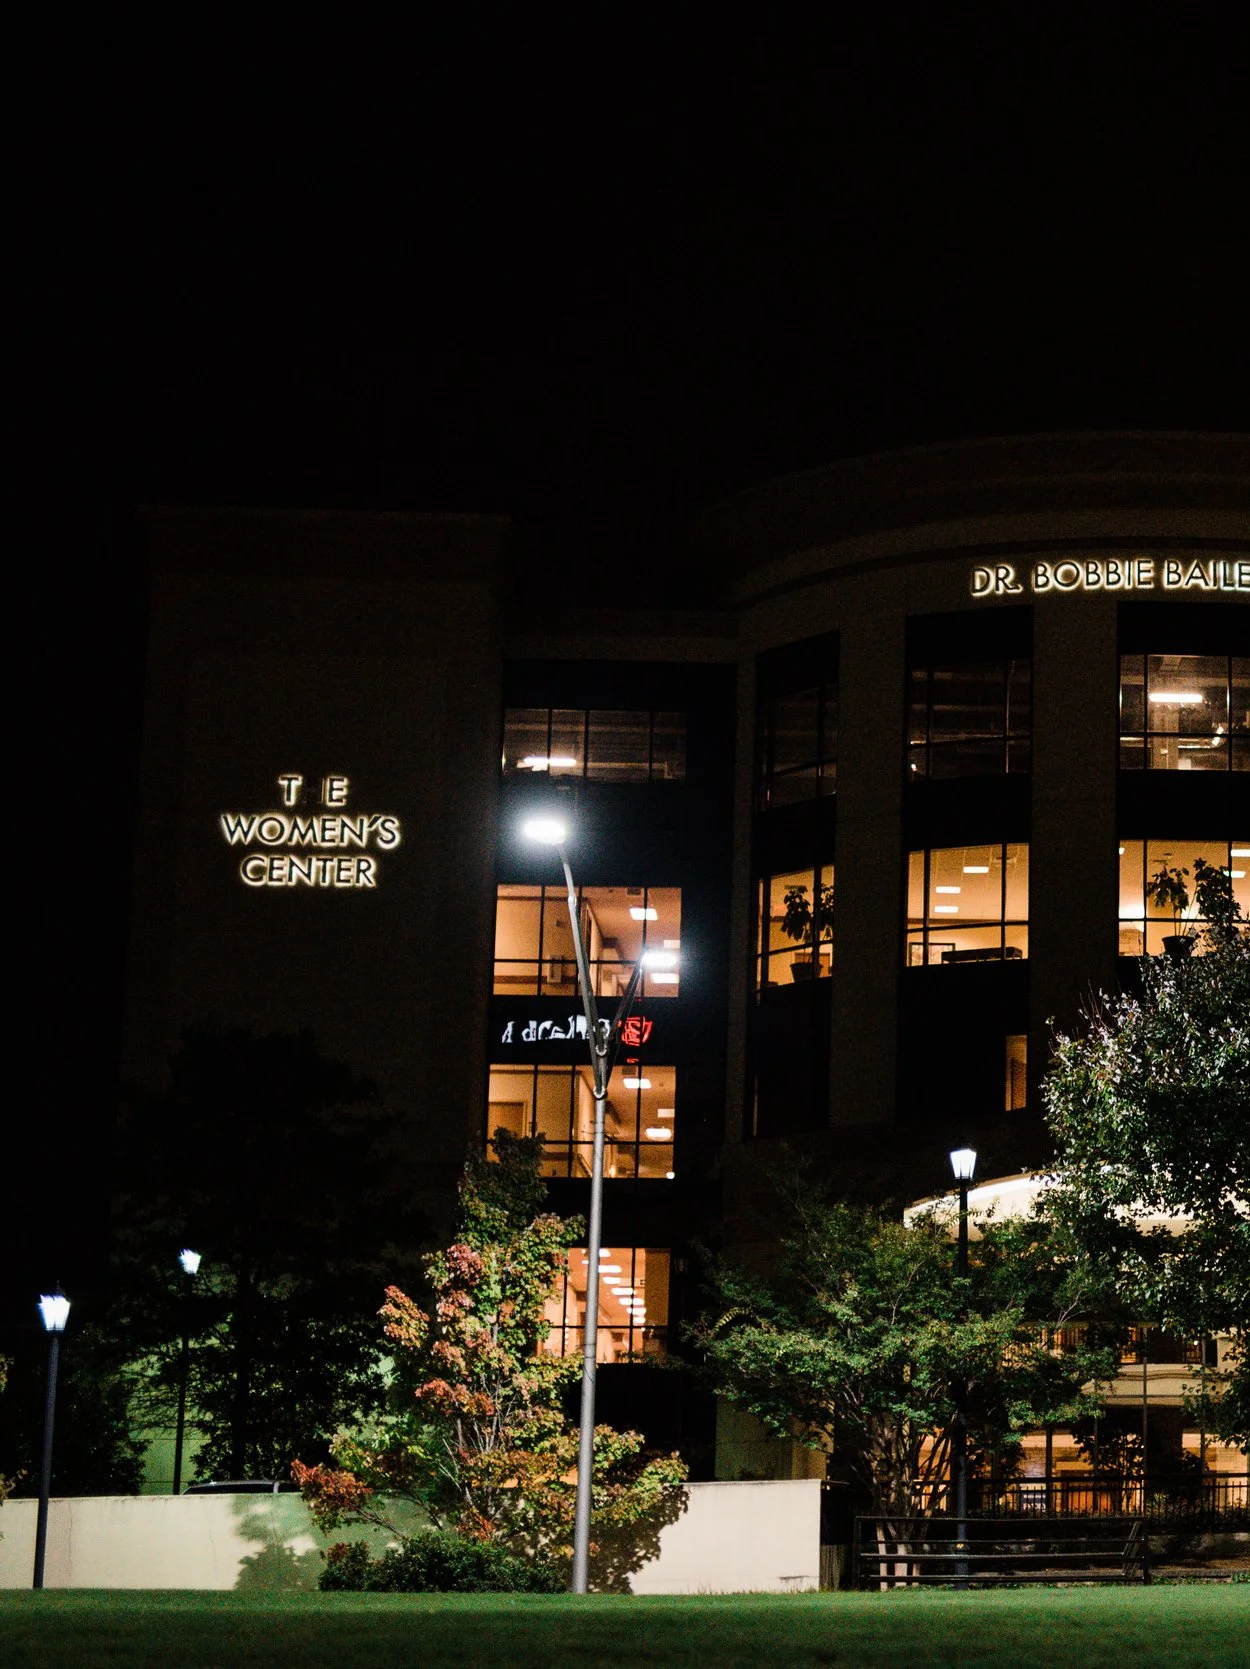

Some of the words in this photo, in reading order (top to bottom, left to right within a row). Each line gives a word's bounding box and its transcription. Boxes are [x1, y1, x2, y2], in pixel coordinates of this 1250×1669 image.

[972, 566, 1021, 595] DR.
[1034, 559, 1153, 590] BOBBIE
[279, 774, 348, 806] TE
[221, 813, 400, 848] WOMEN'S
[241, 855, 376, 886] CENTER
